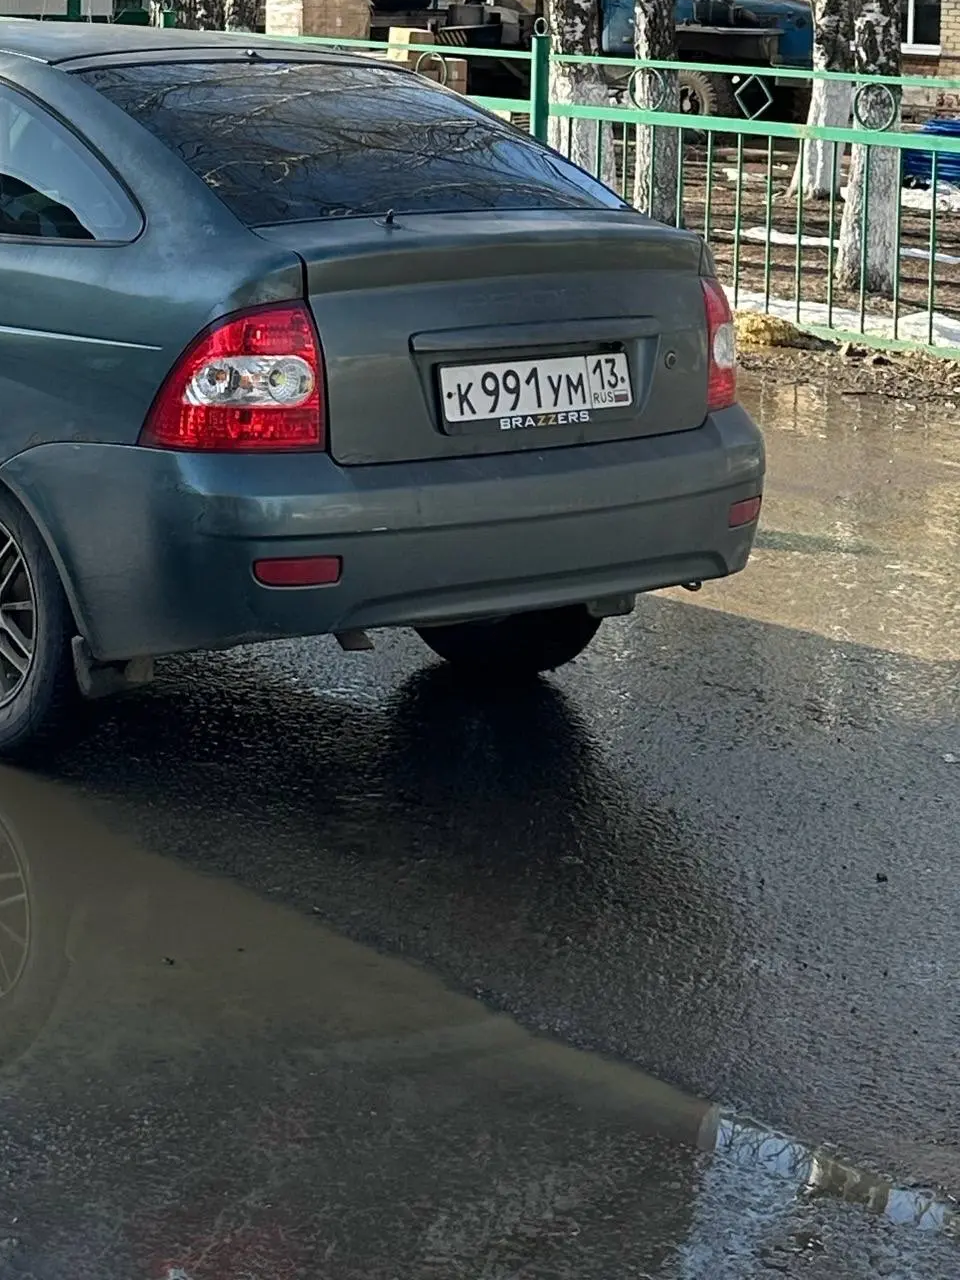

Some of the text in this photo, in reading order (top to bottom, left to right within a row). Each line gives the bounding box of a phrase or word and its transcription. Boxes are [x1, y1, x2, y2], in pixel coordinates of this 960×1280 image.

[456, 358, 619, 416] К991УМ 13
[593, 391, 614, 404] RUS
[500, 410, 590, 430] BRAZZERS
